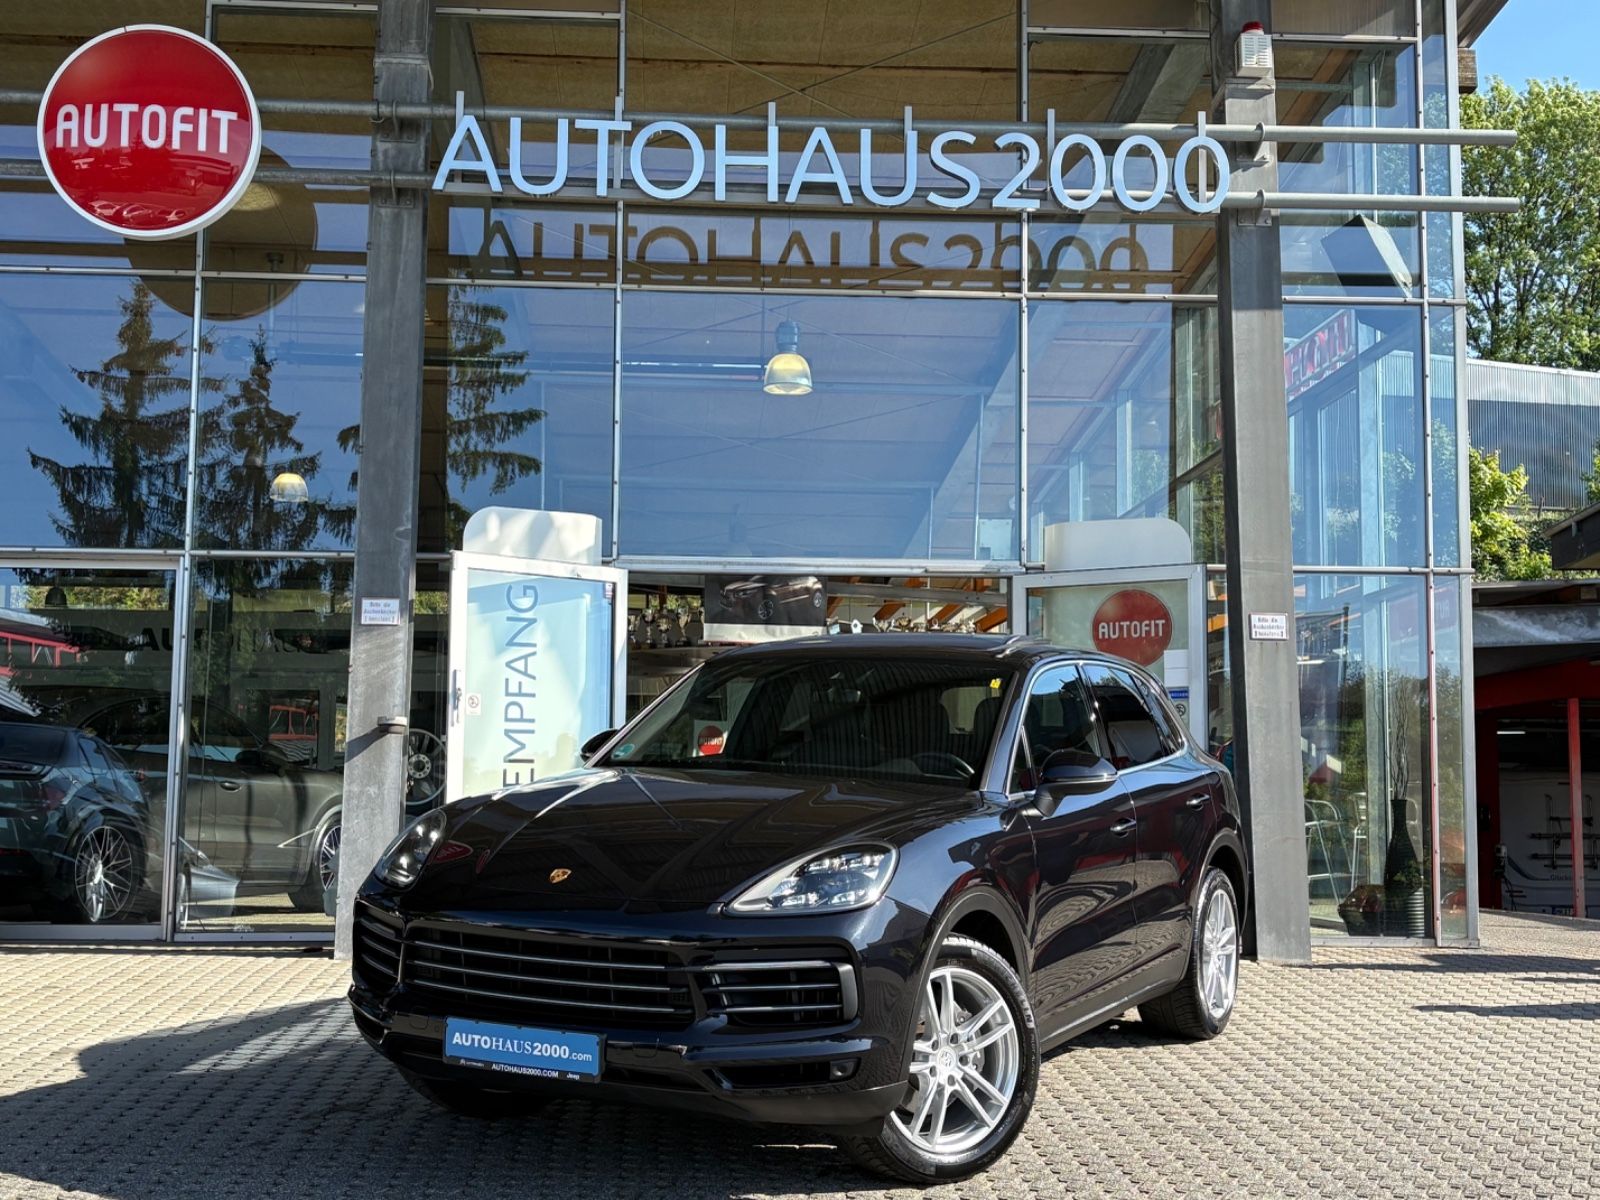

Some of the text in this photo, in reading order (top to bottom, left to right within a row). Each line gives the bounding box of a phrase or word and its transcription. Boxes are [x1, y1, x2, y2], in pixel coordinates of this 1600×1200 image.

[55, 103, 238, 154] AUTOFIT
[431, 114, 1231, 214] AUTOHAUS2000
[1098, 619, 1166, 640] AUTOFIT
[502, 584, 539, 788] EMPFANG
[452, 1032, 593, 1061] AUTOHAUS2000.com
[491, 1063, 559, 1078] AUTOHAUS2000.COM
